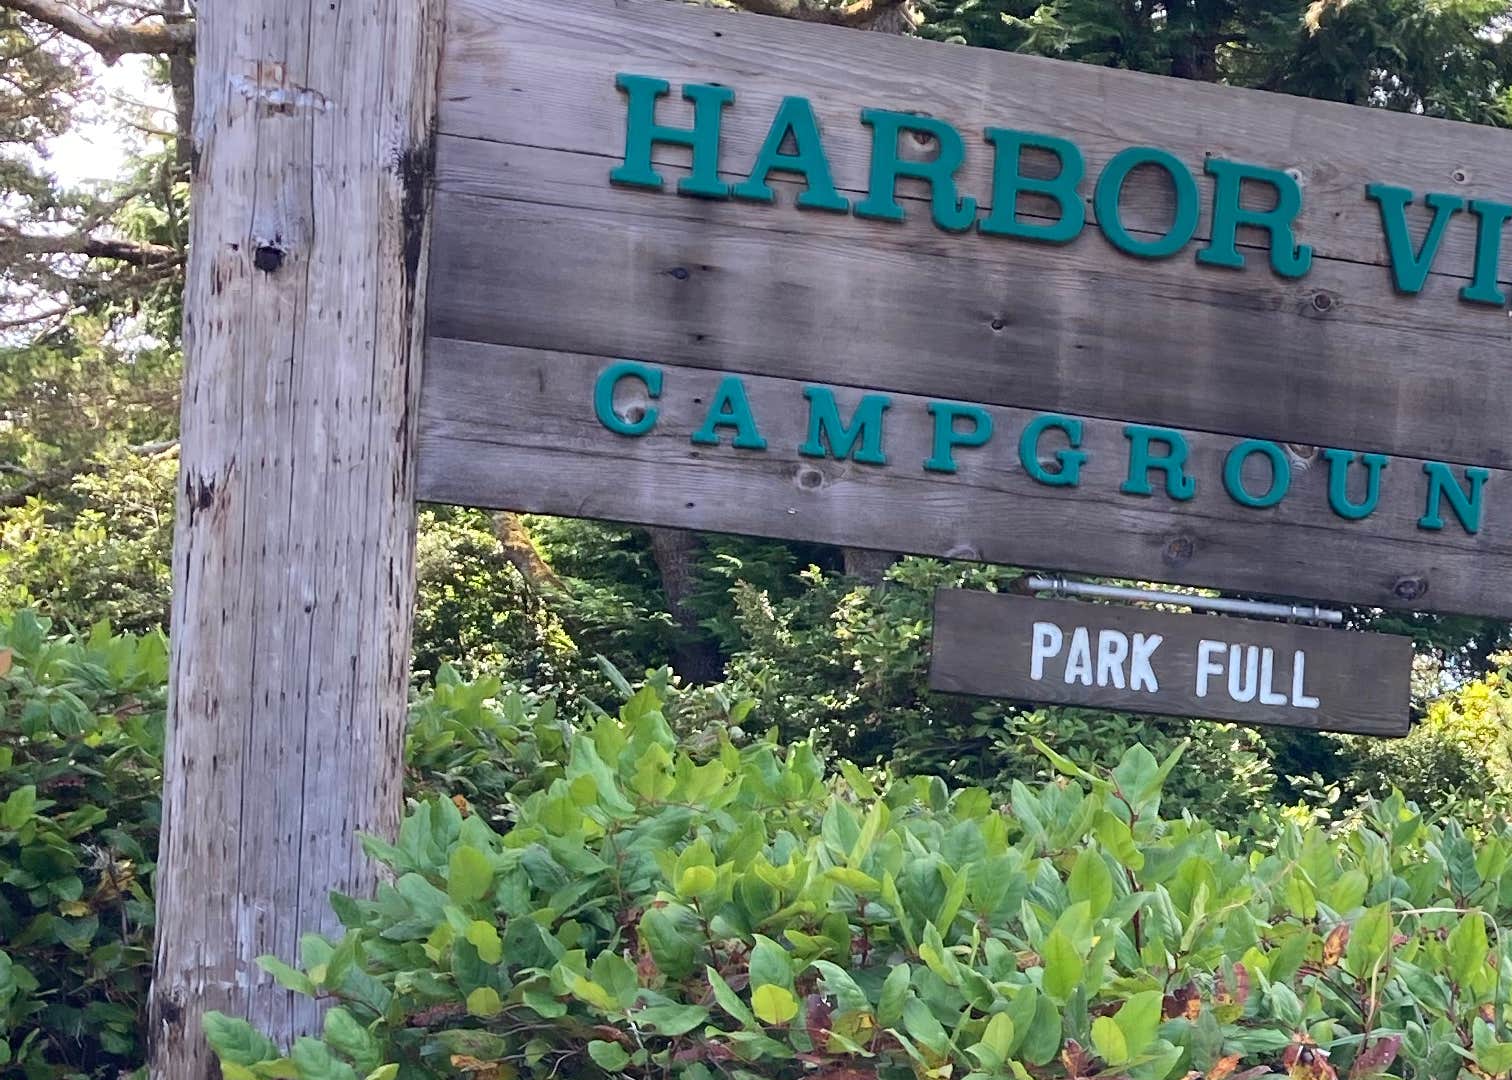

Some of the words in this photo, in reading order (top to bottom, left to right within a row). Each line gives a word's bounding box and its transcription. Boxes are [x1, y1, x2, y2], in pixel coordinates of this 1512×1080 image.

[610, 73, 1313, 278] HARBOR
[1030, 621, 1164, 693] PARK
[1195, 639, 1320, 709] FULL
